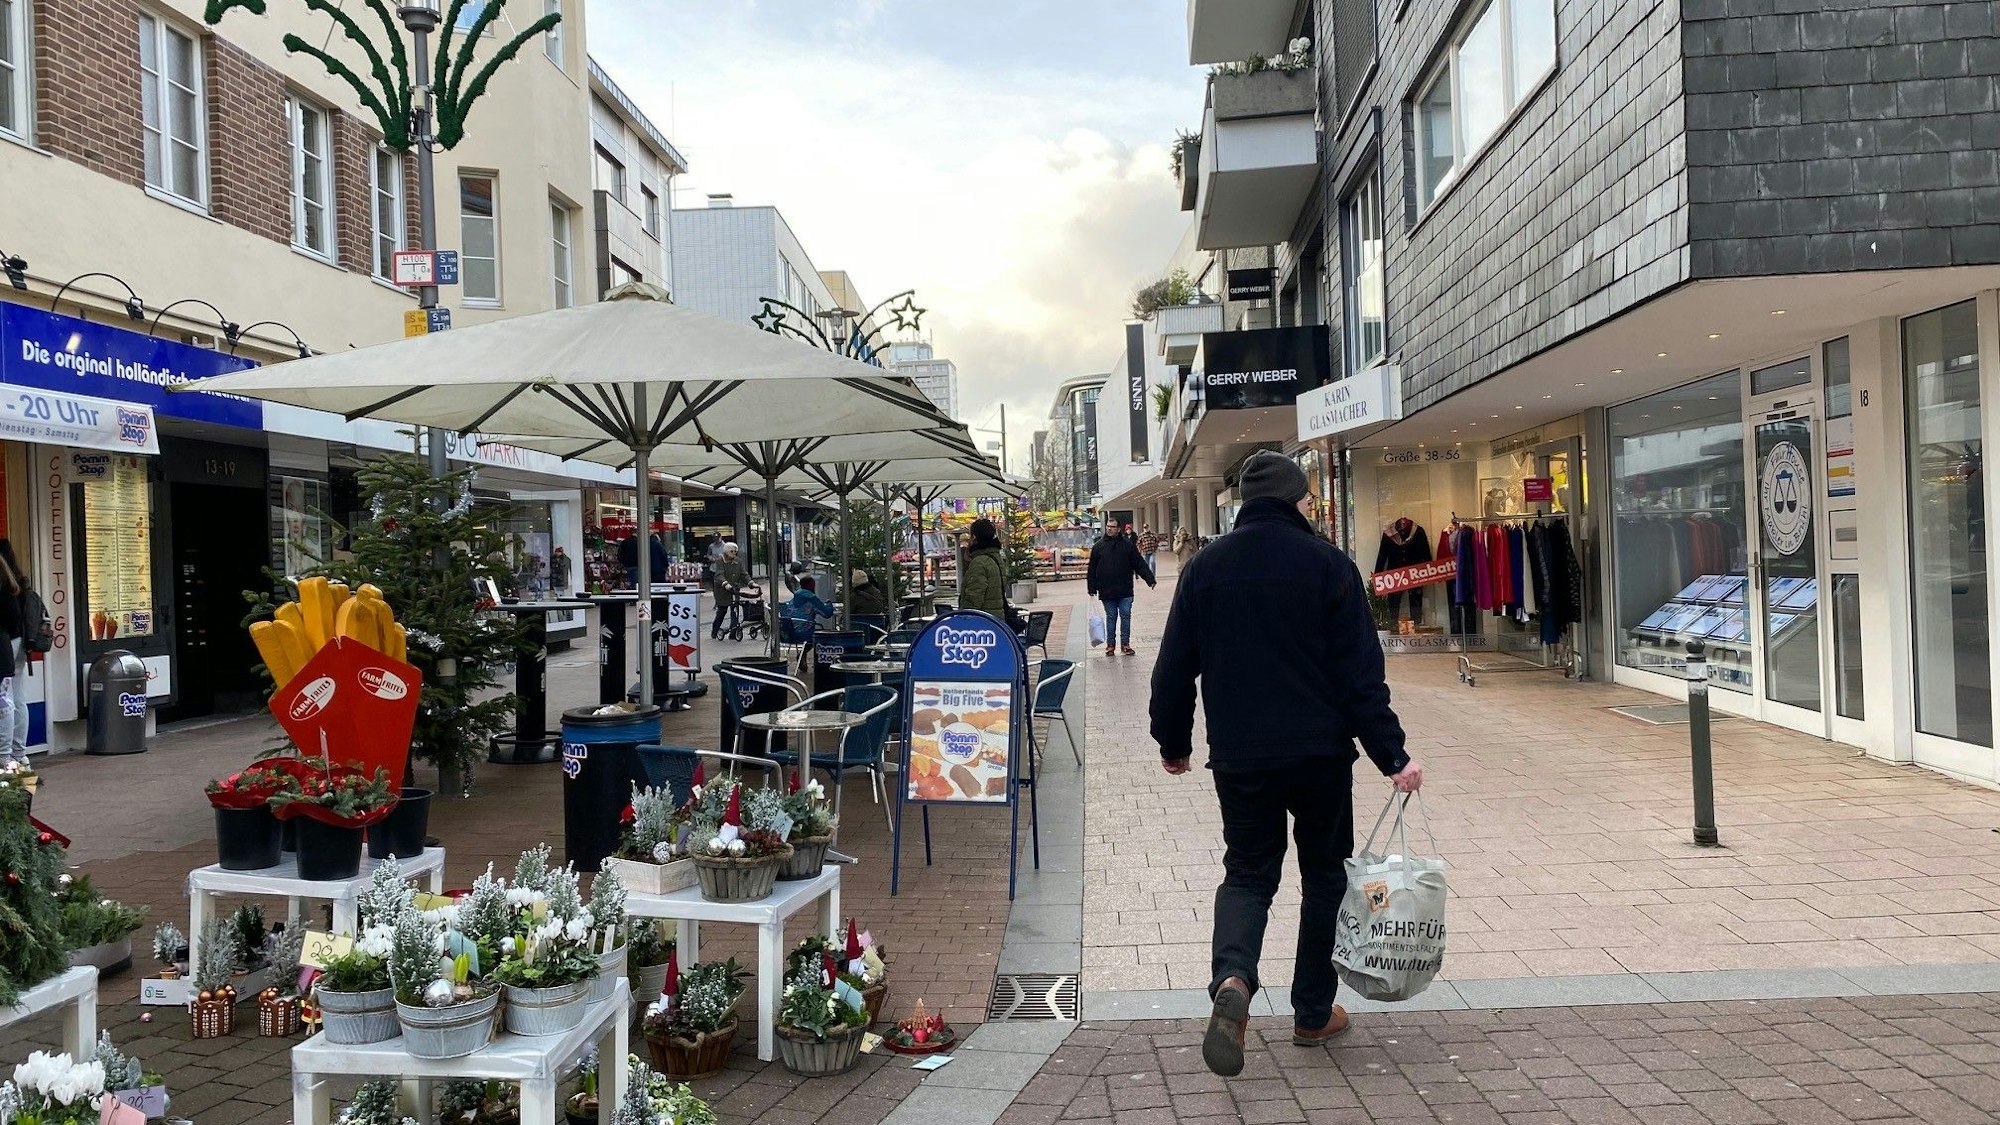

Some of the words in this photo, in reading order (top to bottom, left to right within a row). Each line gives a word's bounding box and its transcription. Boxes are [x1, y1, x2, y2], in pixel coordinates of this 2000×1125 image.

[1229, 286, 1249, 294] GERRY
[1250, 285, 1271, 293] WEBER
[22, 340, 51, 364] Die
[54, 351, 112, 377] original
[116, 359, 195, 386] holländisch
[1207, 371, 1250, 386] GERRY
[1252, 368, 1297, 383] WEBER
[1324, 385, 1351, 407] KARIN
[1860, 389, 1869, 407] 18
[19, 394, 51, 421] 20
[56, 399, 101, 427] Uhr
[117, 407, 149, 426] Pomm
[1309, 400, 1368, 431] GLASMACHER
[46, 427, 80, 441] Samstag
[121, 425, 146, 445] Stop
[73, 454, 110, 465] Pomm
[1384, 452, 1421, 464] Größe
[1424, 451, 1460, 461] 38-56
[79, 464, 106, 477] Stop
[205, 459, 236, 476] 13-19
[48, 456, 65, 560] COFFEE
[1375, 570, 1409, 592] 50%
[1408, 560, 1457, 580] Rabatt
[52, 572, 66, 605] TO
[131, 612, 150, 623] Pomm
[53, 616, 67, 649] GO
[133, 622, 149, 632] Stop
[936, 626, 995, 646] Pomm
[1380, 639, 1406, 648] ARIN
[1408, 638, 1487, 648] GLASMACHER
[942, 647, 986, 668] Stop
[361, 671, 382, 685] FARM
[381, 680, 405, 694] FRITES
[119, 693, 146, 705] Pom
[292, 697, 314, 717] FARM
[310, 680, 331, 702] FRITES
[943, 695, 960, 707] Big
[962, 694, 984, 706] Five
[943, 731, 979, 743] Pomm
[947, 743, 975, 757] Stop
[1371, 921, 1416, 939] MEHR
[1418, 918, 1445, 941] FÜR
